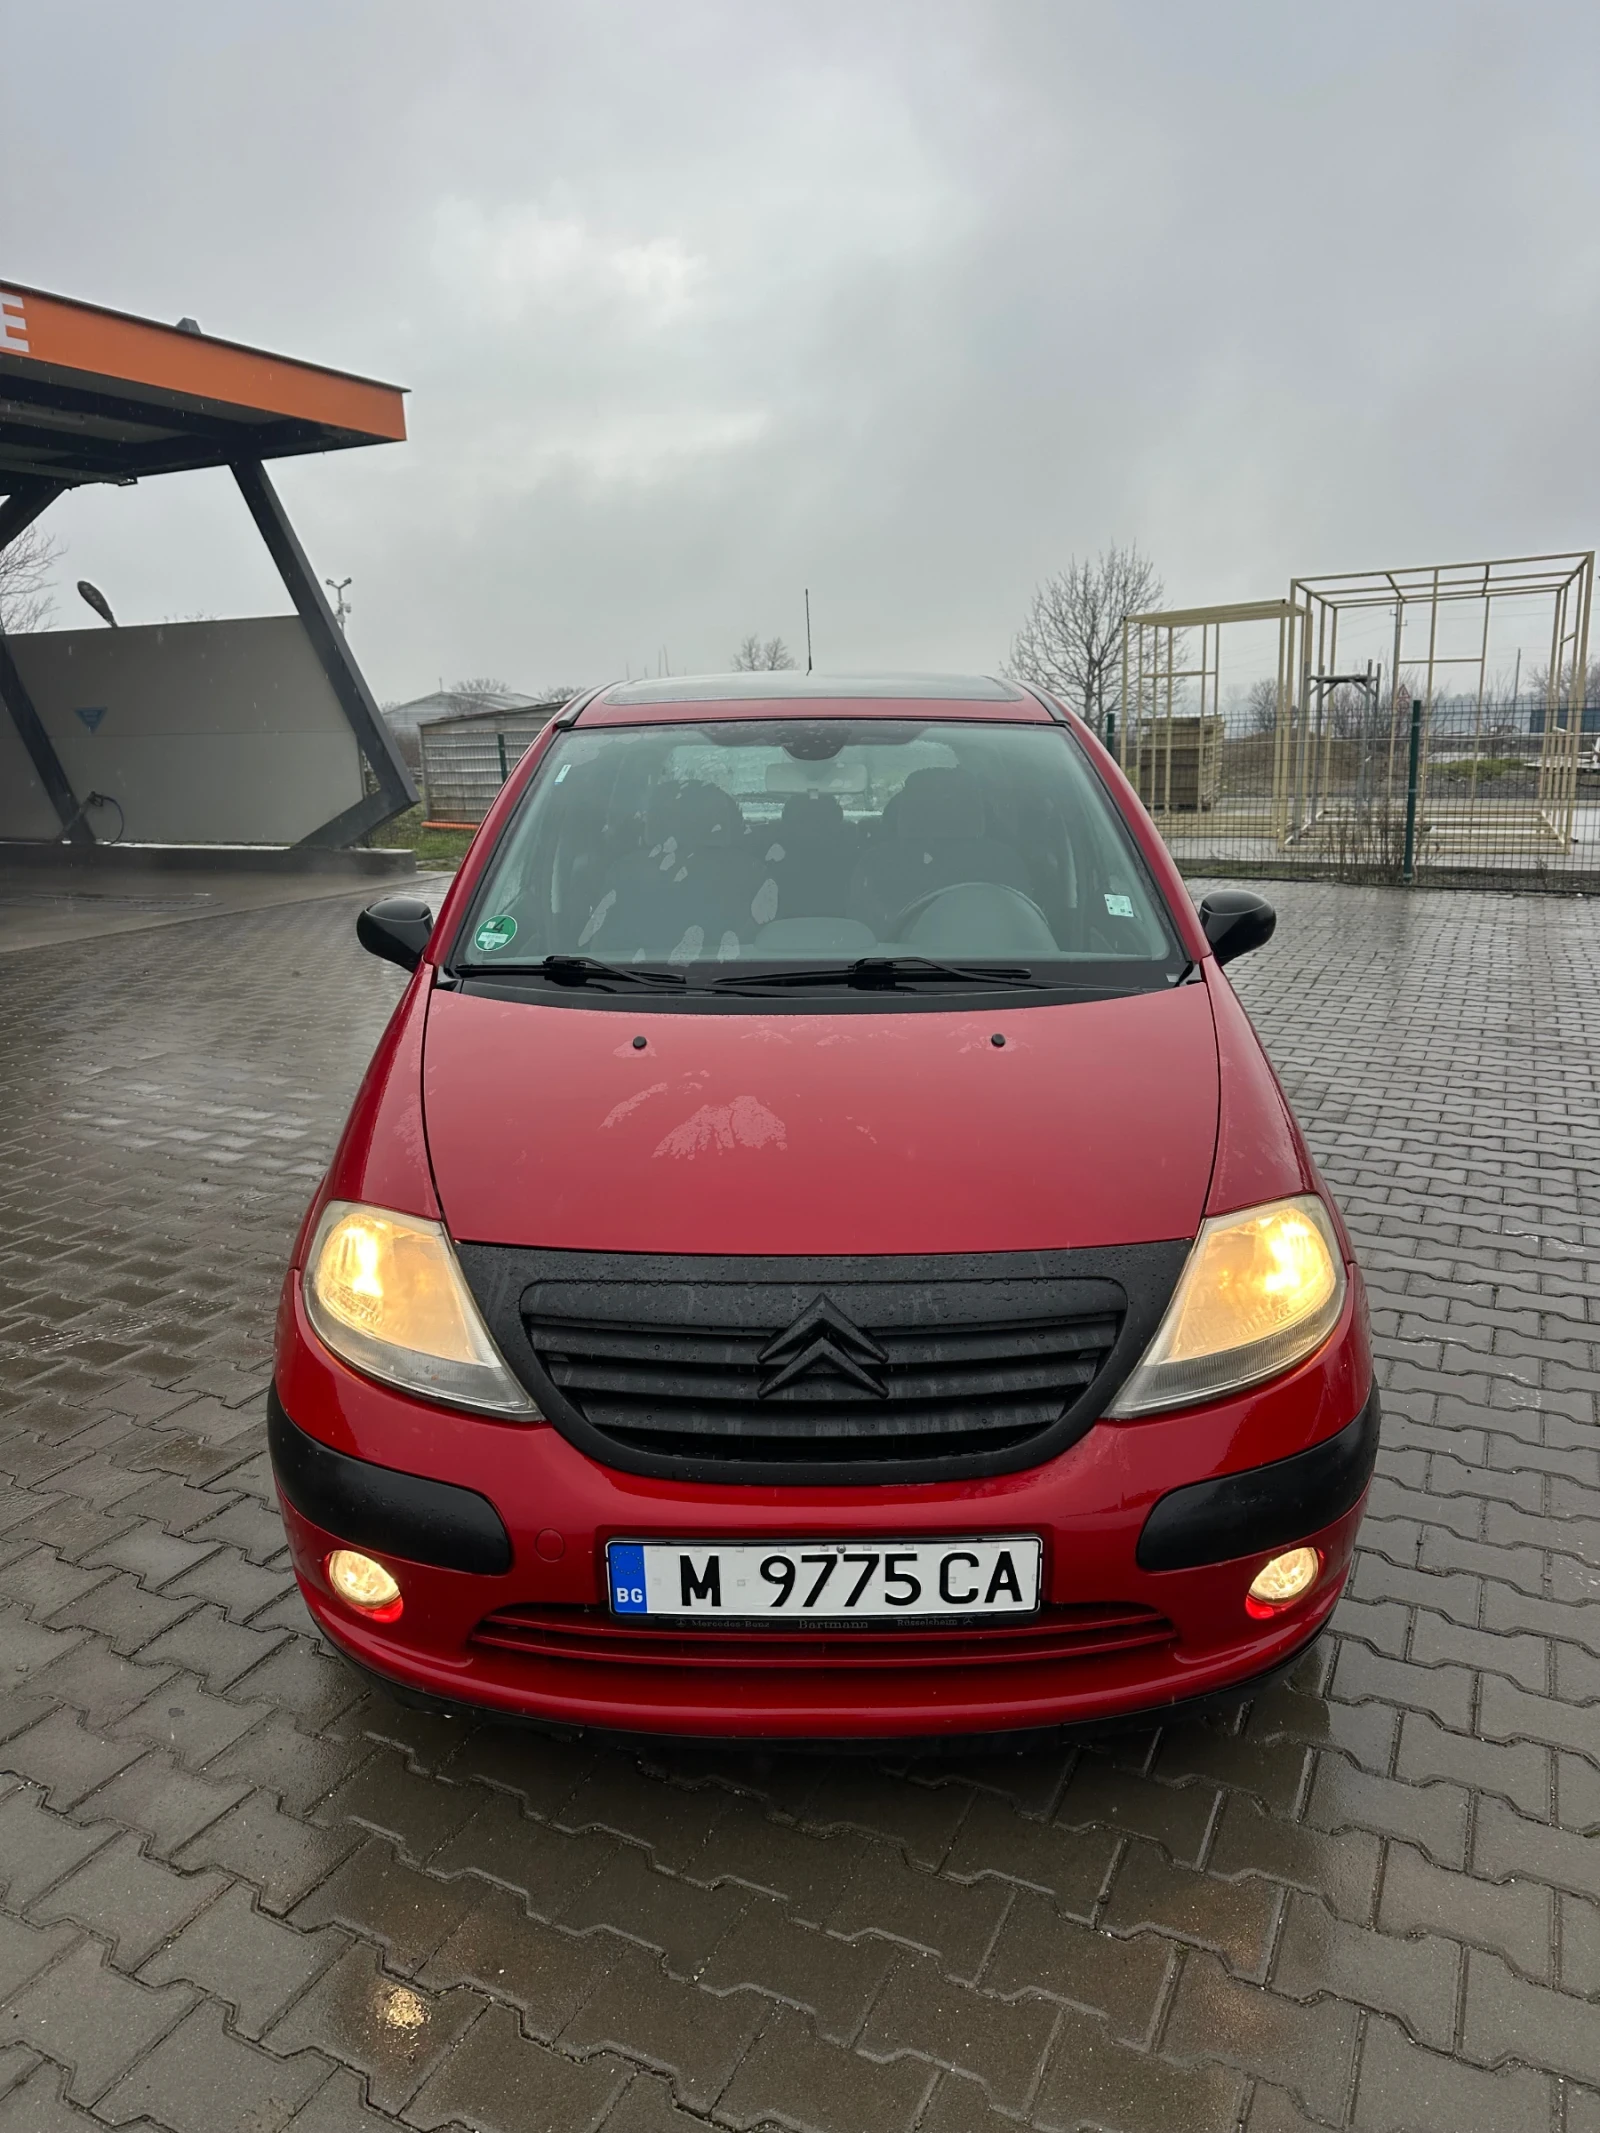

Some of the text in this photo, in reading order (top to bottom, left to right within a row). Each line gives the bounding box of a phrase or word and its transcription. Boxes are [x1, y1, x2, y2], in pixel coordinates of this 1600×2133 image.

[492, 917, 507, 933] 4
[679, 1550, 1023, 1607] M 9775 CA
[616, 1587, 643, 1603] BG
[798, 1619, 868, 1629] Bartmann
